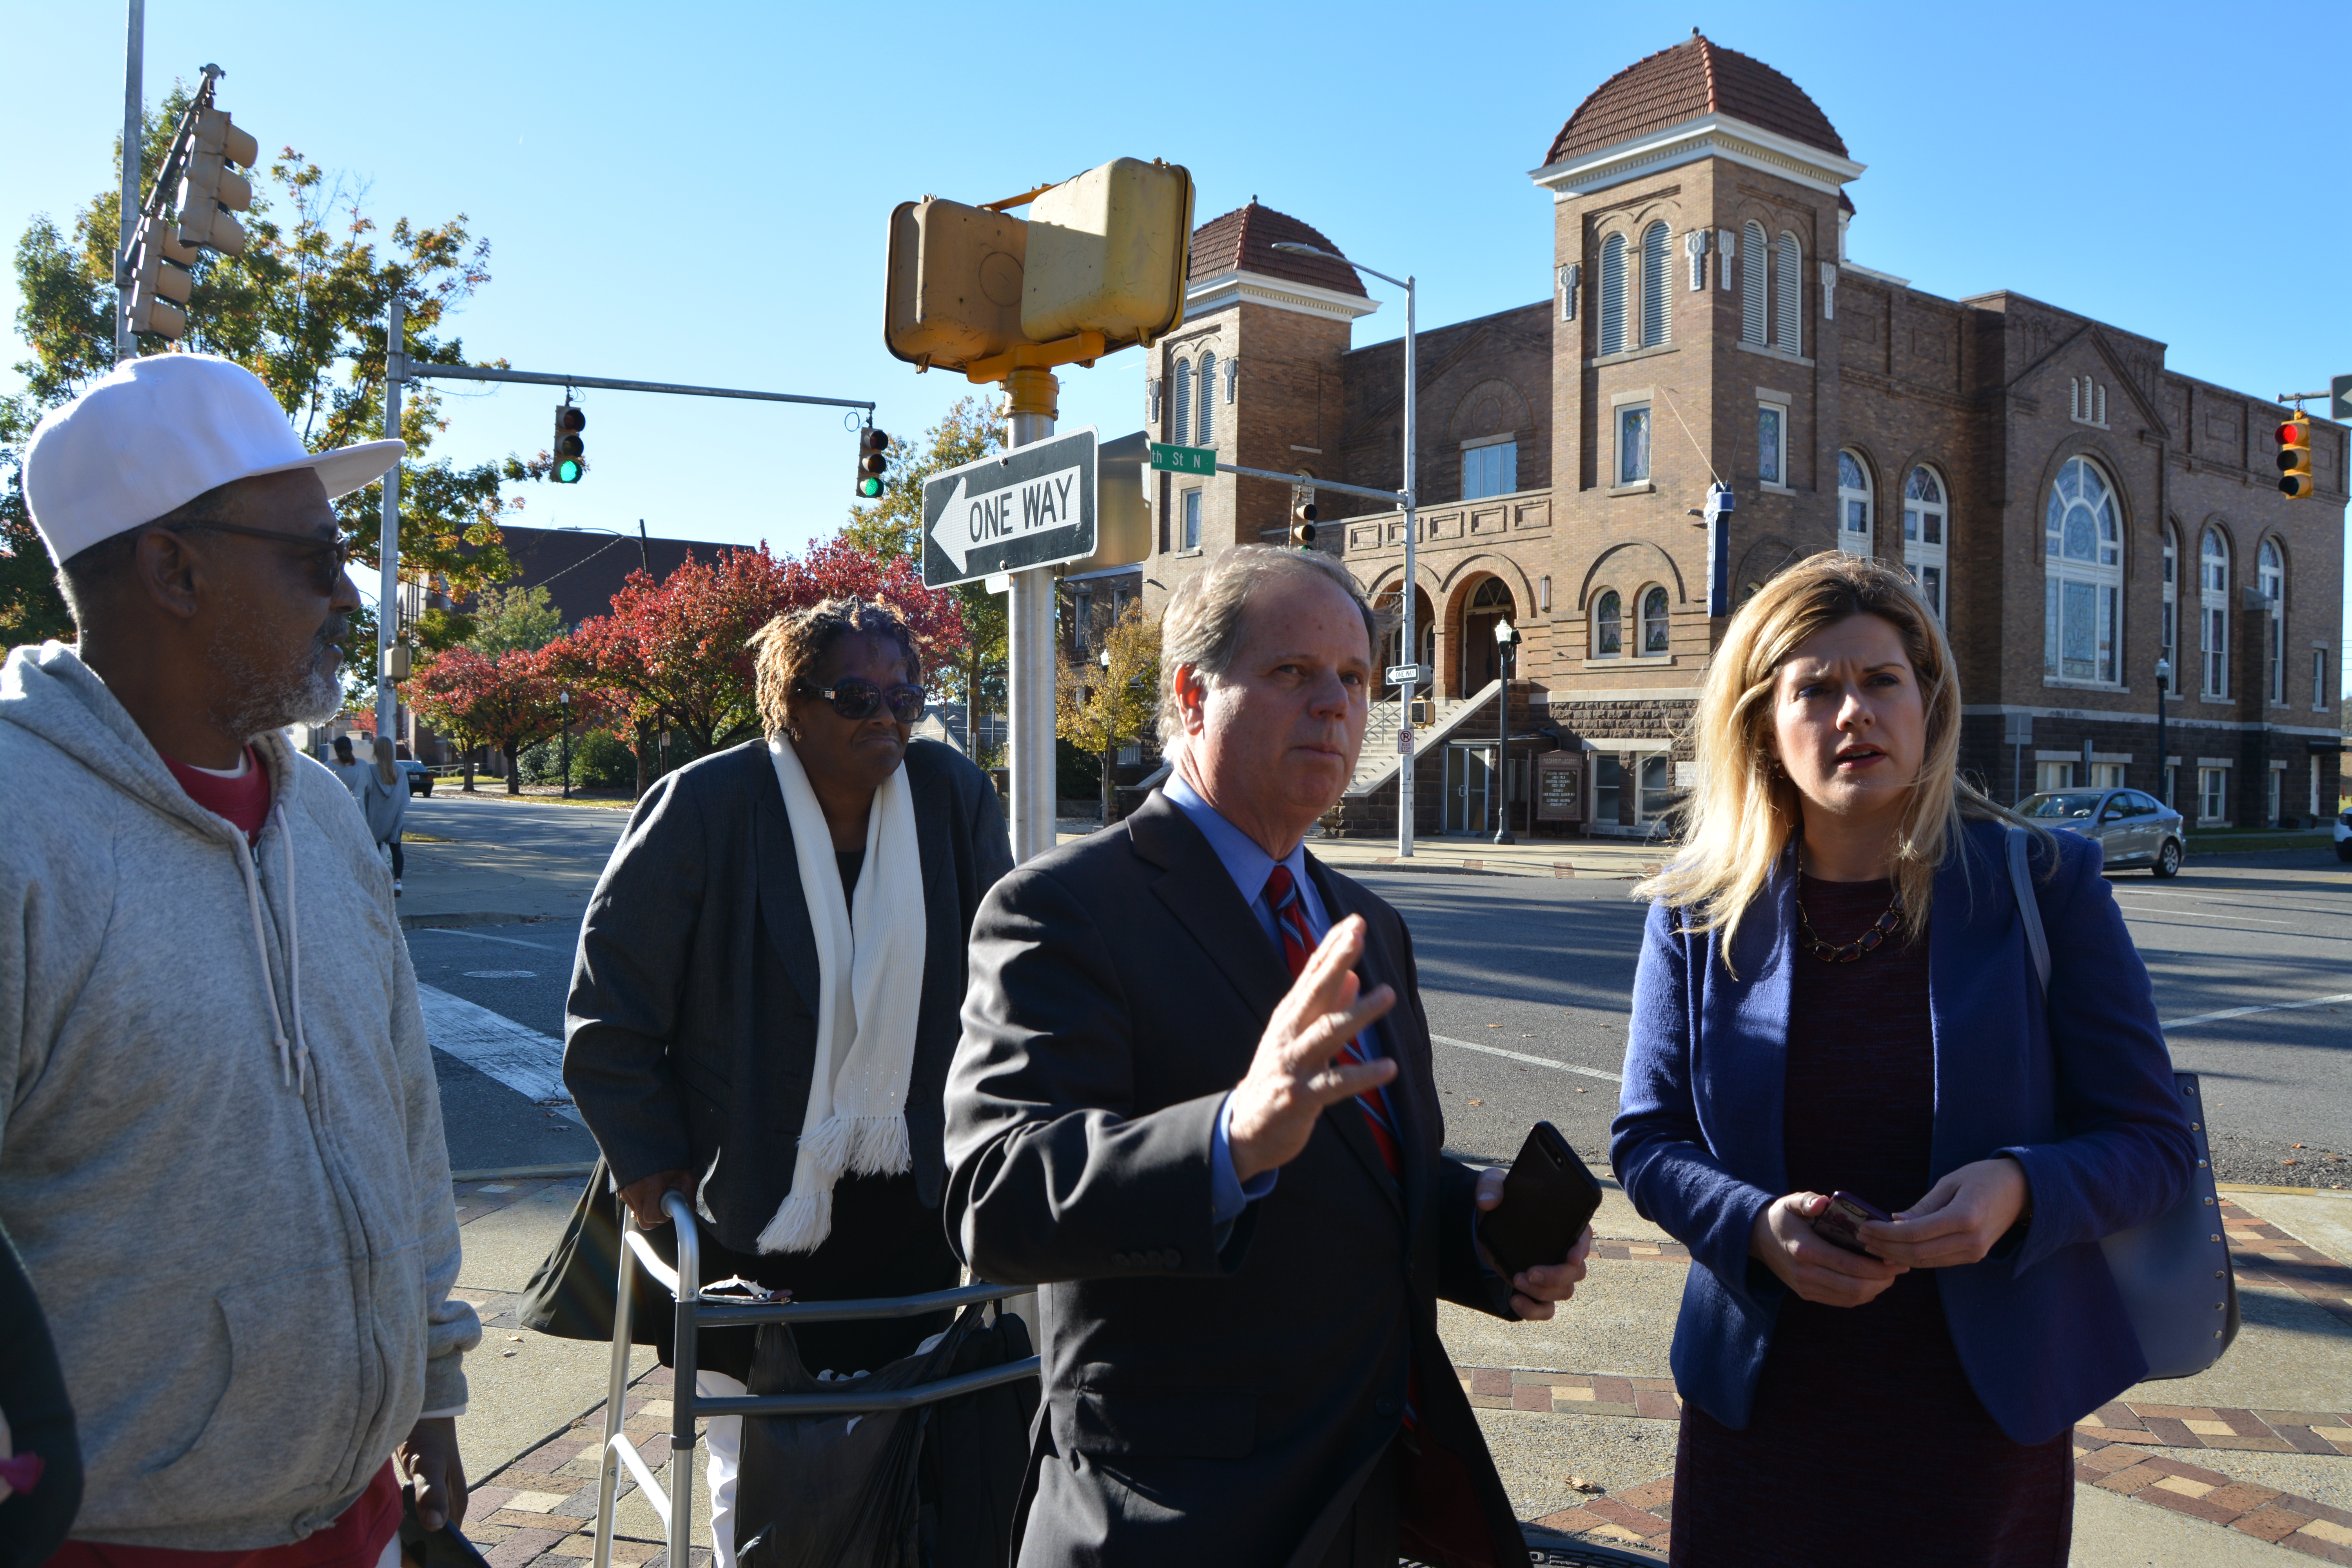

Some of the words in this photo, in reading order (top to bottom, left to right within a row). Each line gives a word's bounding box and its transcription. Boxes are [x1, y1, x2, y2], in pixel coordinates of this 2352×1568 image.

[1151, 450, 1162, 463] th
[1172, 452, 1183, 466] St
[1194, 454, 1200, 468] N
[969, 492, 1013, 543] ONE
[1022, 474, 1073, 529] WAY
